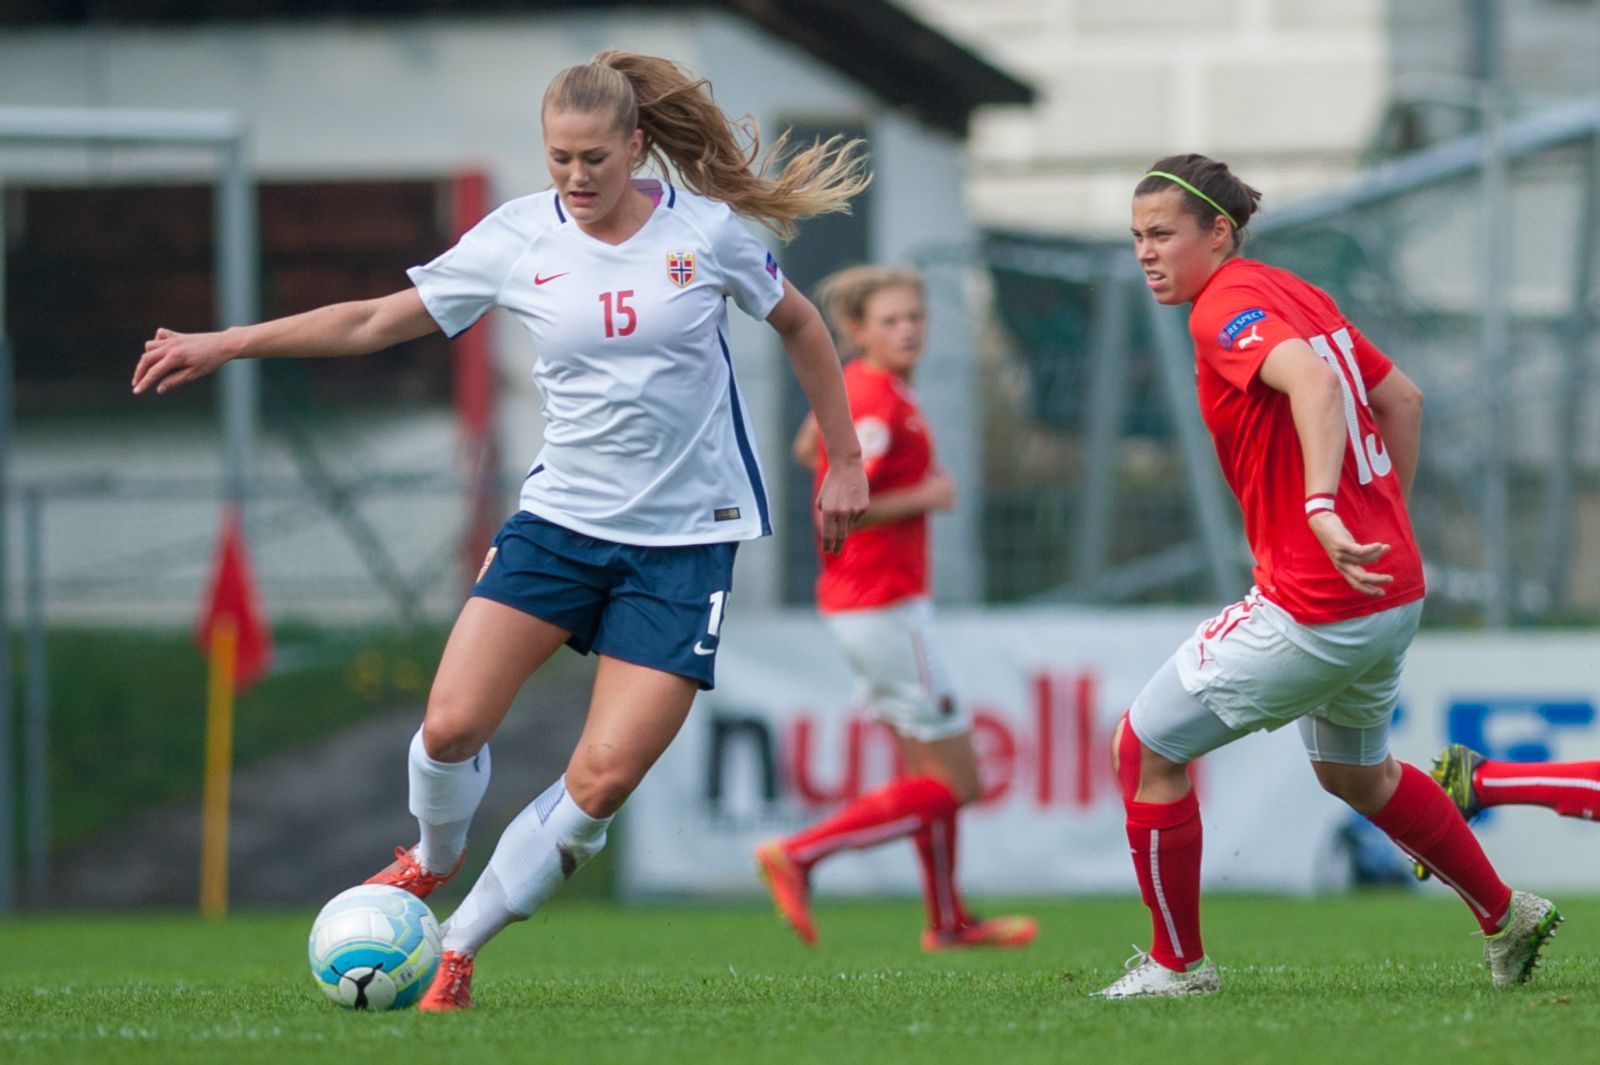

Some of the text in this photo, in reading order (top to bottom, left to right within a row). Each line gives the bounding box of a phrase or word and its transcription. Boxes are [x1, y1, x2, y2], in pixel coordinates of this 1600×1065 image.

[598, 289, 637, 338] 15
[1226, 309, 1265, 337] RESPECT
[707, 590, 729, 638] 1
[705, 668, 1200, 810] nuell
